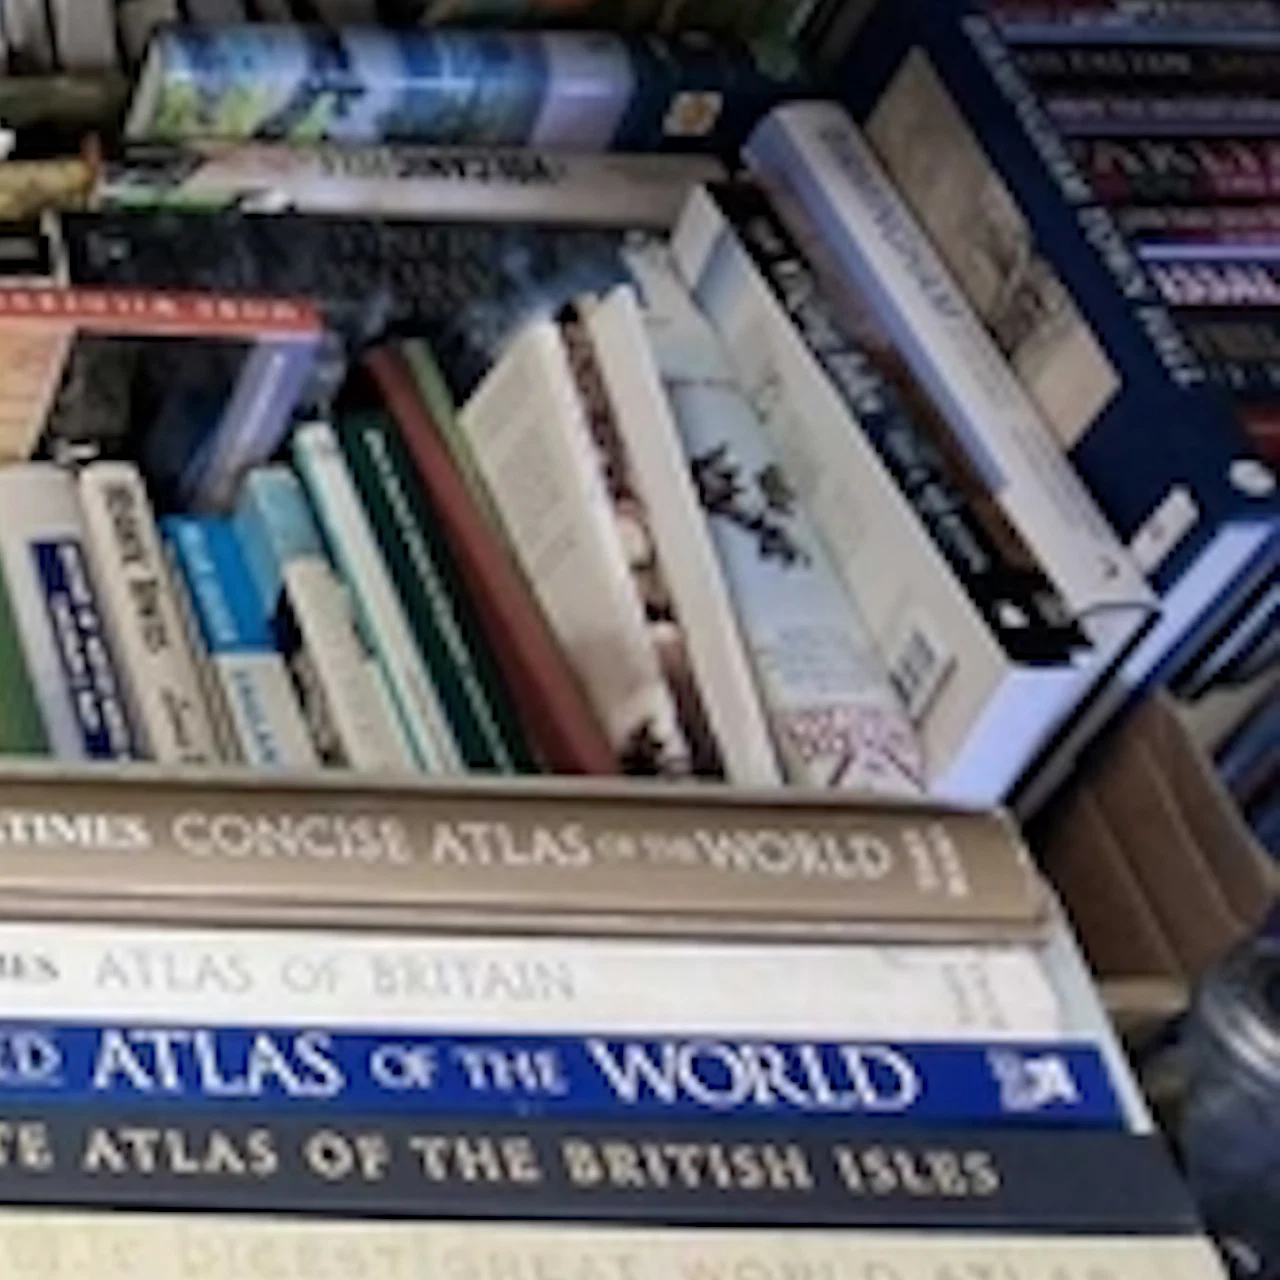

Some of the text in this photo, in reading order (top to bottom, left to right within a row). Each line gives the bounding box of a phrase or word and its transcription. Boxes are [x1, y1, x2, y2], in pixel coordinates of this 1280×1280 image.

[0, 810, 153, 849] TIMES
[172, 809, 410, 864] CONCISE
[434, 821, 593, 868] ATLAS
[698, 825, 892, 879] WORLD
[95, 948, 254, 996] ATLAS
[281, 956, 344, 997] OF
[371, 957, 577, 1004] BRITAIN
[91, 1026, 346, 1098] ATLAS
[369, 1044, 440, 1093] OF
[451, 1047, 570, 1097] THE
[589, 1037, 922, 1113] WORLD
[81, 1128, 280, 1177] ATLAS
[302, 1132, 392, 1183] OF
[409, 1136, 542, 1186] THE
[561, 1140, 813, 1193] BRITISH
[835, 1149, 1003, 1199] ISLES
